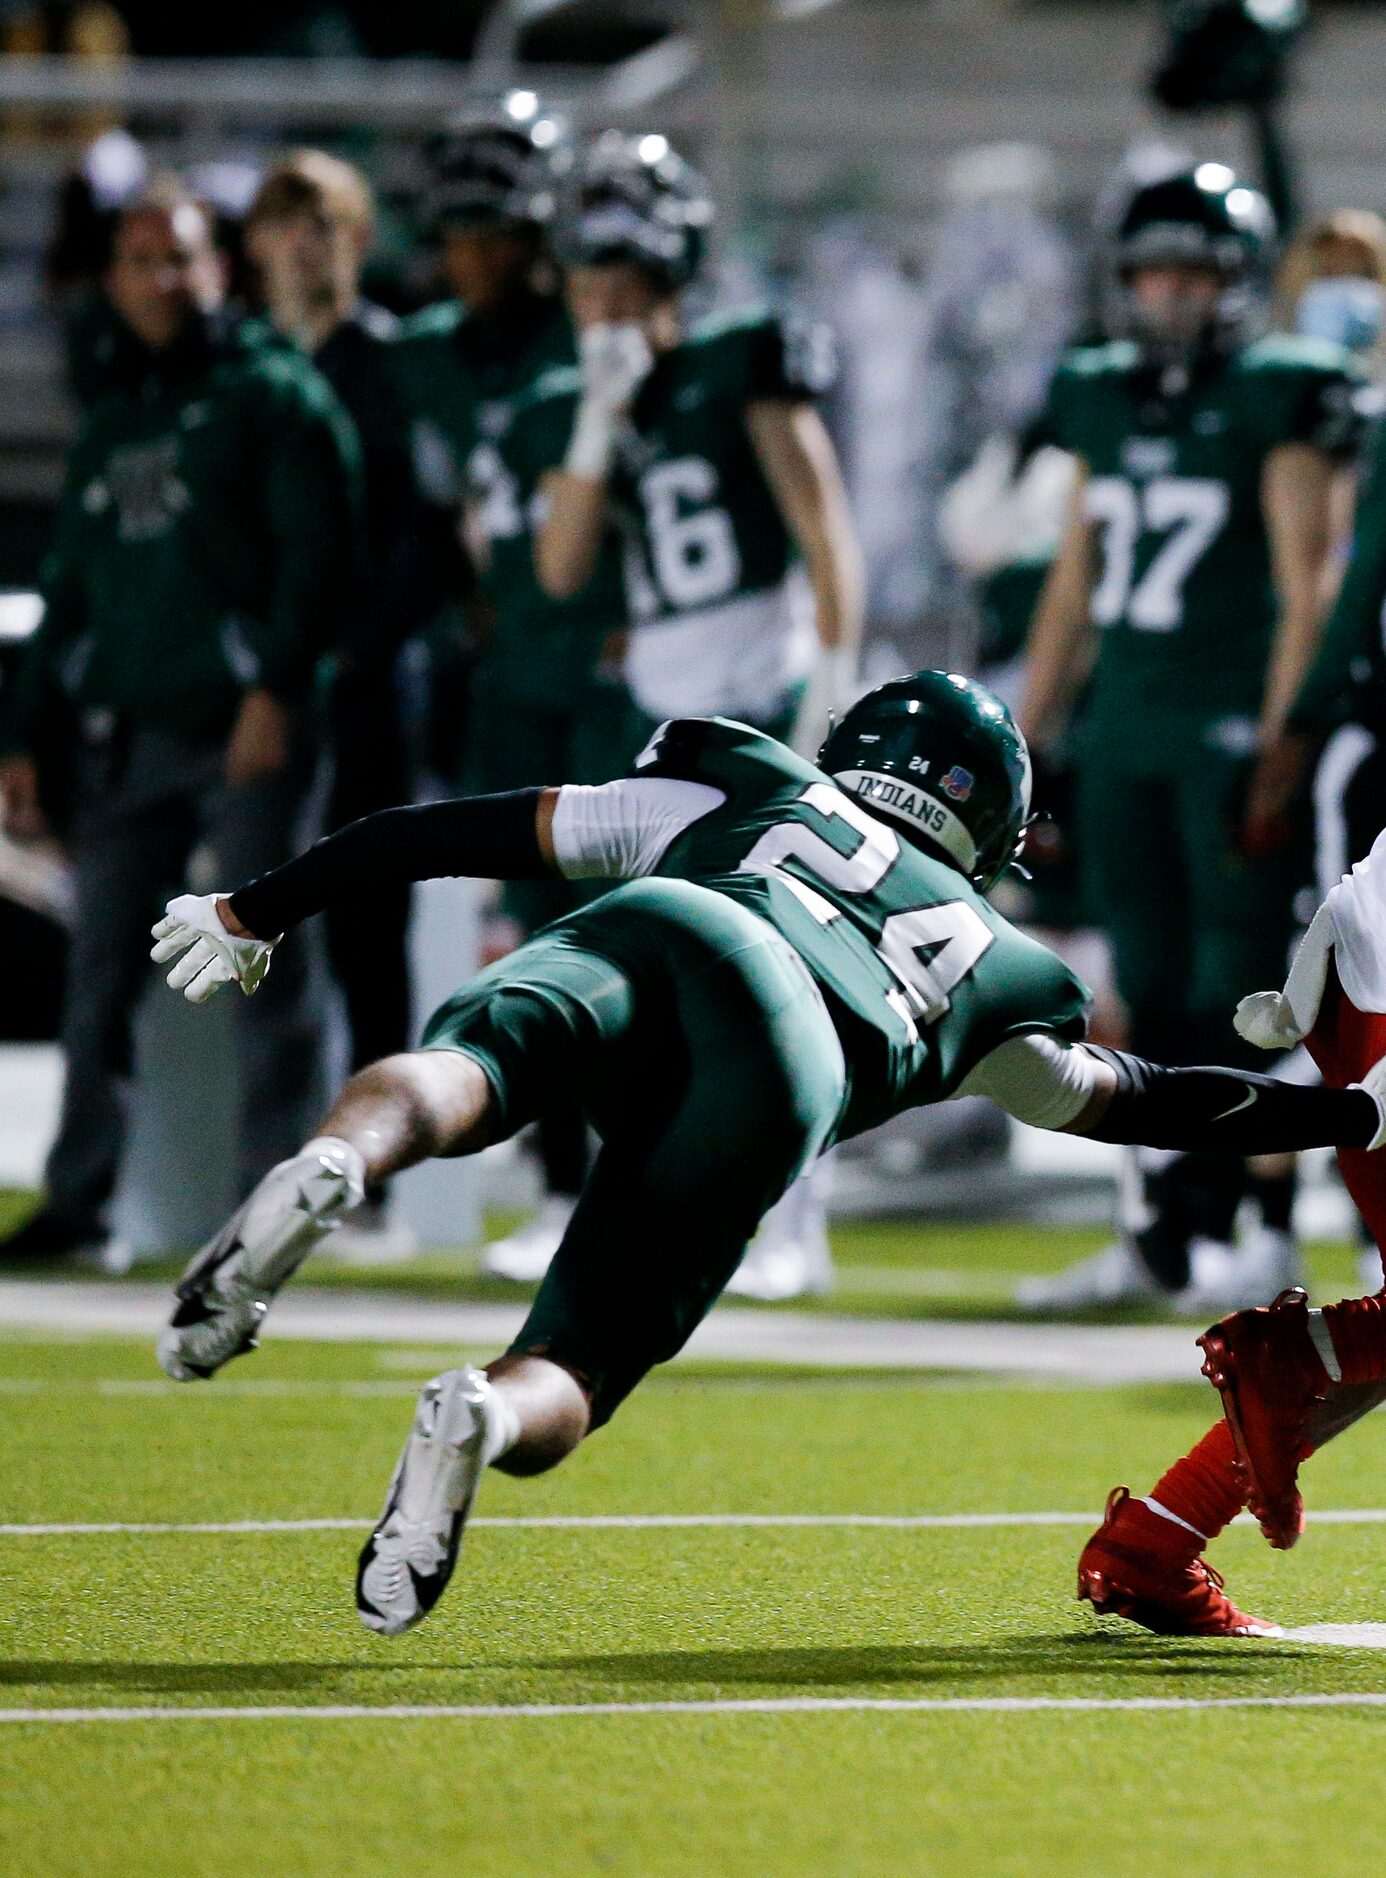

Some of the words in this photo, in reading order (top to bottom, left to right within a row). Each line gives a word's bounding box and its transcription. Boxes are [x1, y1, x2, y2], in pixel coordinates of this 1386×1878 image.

[908, 756, 930, 775] 24
[855, 776, 948, 832] INDIANS
[735, 782, 996, 1045] 24
